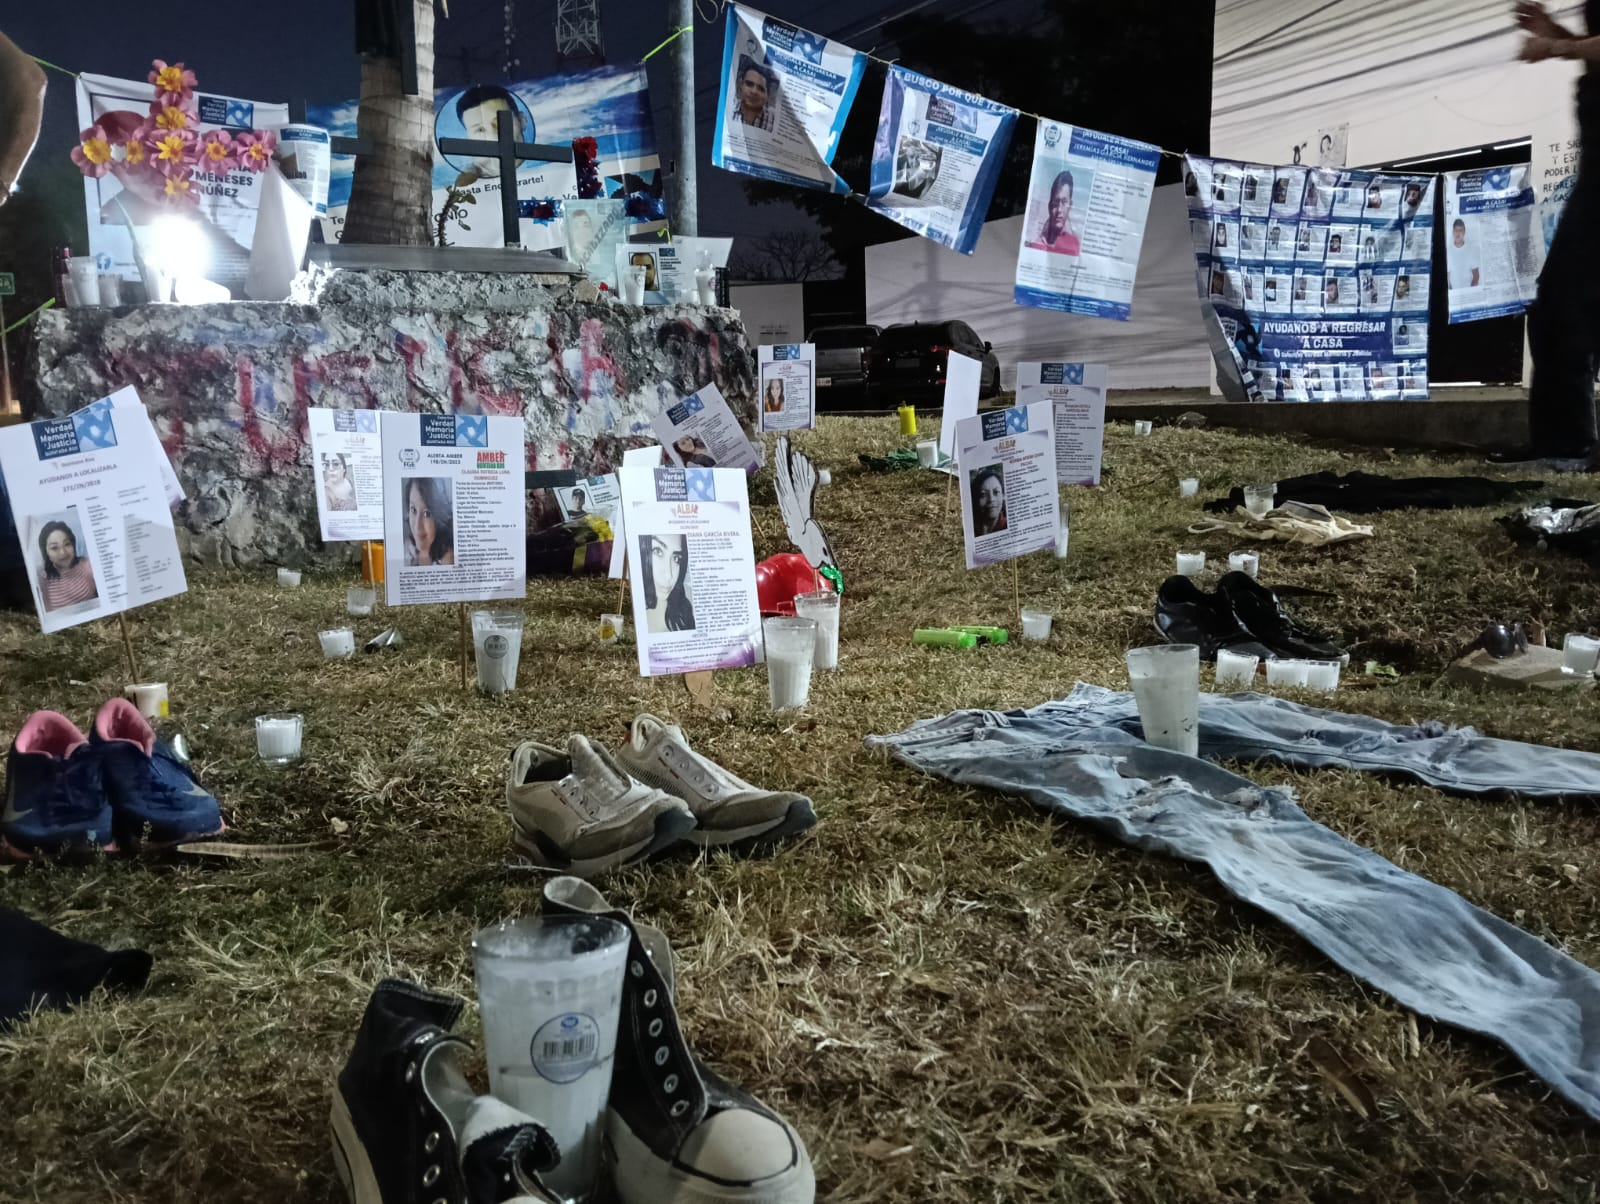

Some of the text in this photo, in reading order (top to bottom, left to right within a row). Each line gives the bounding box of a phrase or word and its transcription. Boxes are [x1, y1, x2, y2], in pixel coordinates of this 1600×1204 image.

[888, 68, 902, 79] TE
[904, 72, 940, 90] BUSCO
[942, 84, 963, 99] POR
[965, 92, 984, 106] QUE
[1549, 143, 1560, 152] TE
[195, 170, 253, 187] MENESES
[1544, 168, 1570, 178] PODER
[1543, 180, 1576, 193] REGRES
[1264, 321, 1386, 334] AYUDANOS A REGRESAR
[1302, 338, 1343, 349] A CASA
[45, 423, 73, 434] Verdad
[40, 431, 75, 443] Memoria
[46, 439, 77, 450] Justicia
[477, 451, 504, 462] AMBER
